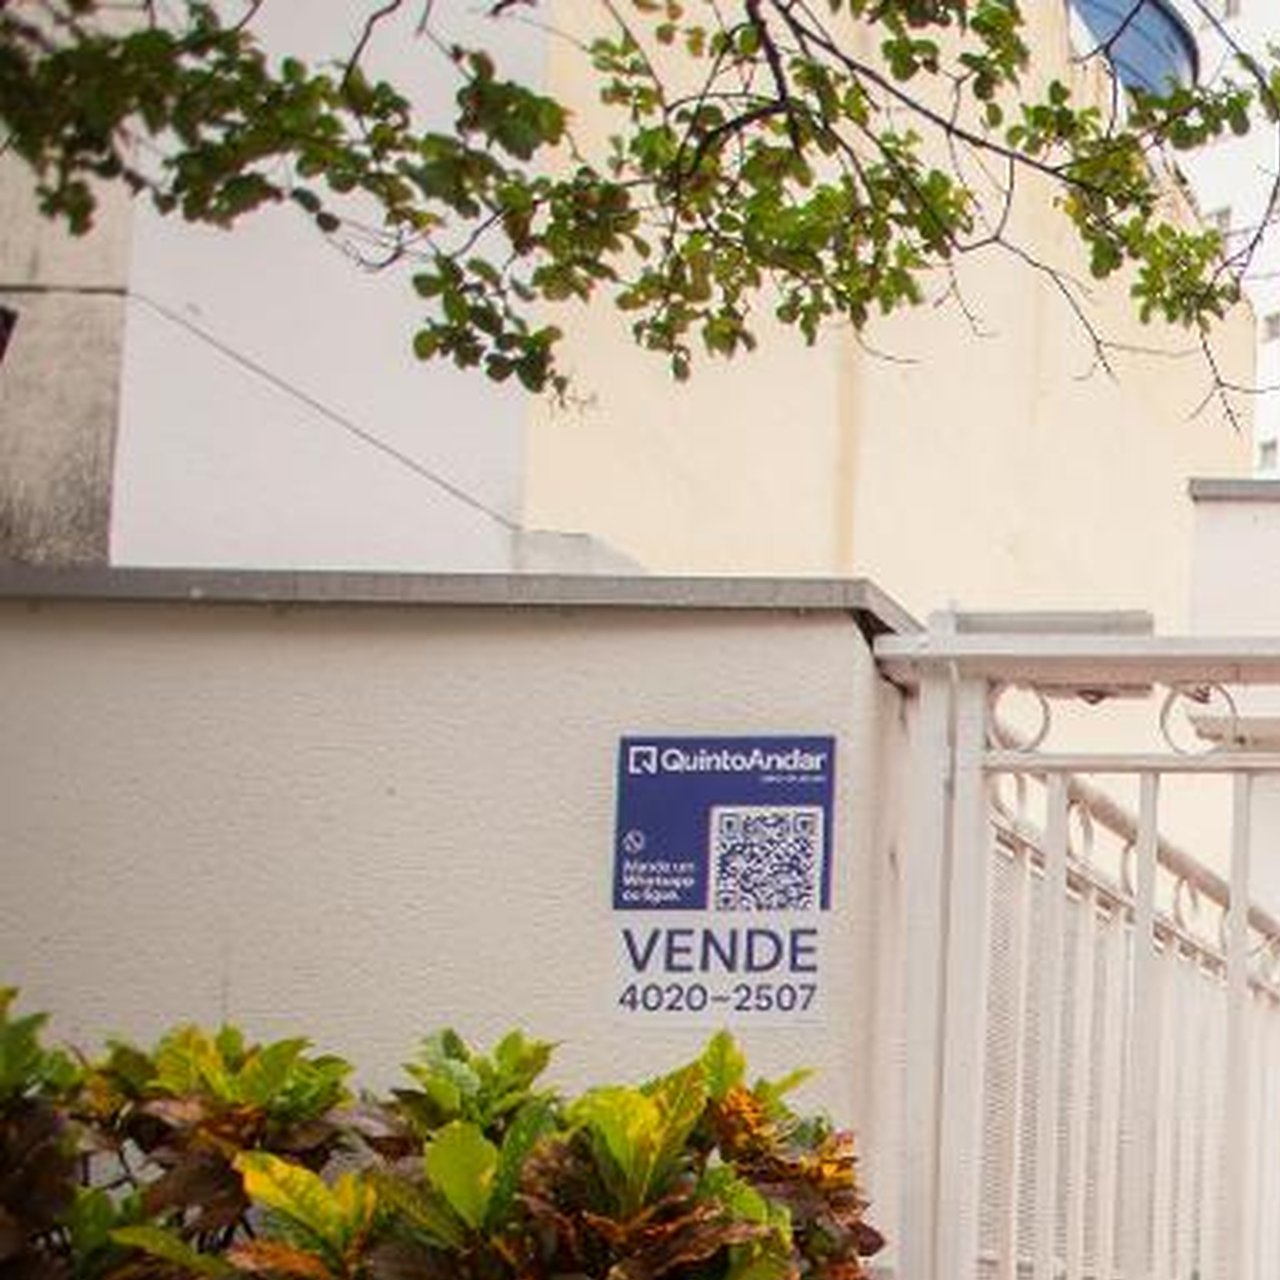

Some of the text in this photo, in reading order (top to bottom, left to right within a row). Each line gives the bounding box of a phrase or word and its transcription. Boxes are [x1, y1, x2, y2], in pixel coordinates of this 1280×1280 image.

[660, 748, 826, 772] QuintoAndar
[622, 929, 818, 973] VENDE
[618, 983, 817, 1013] 4020-2507
